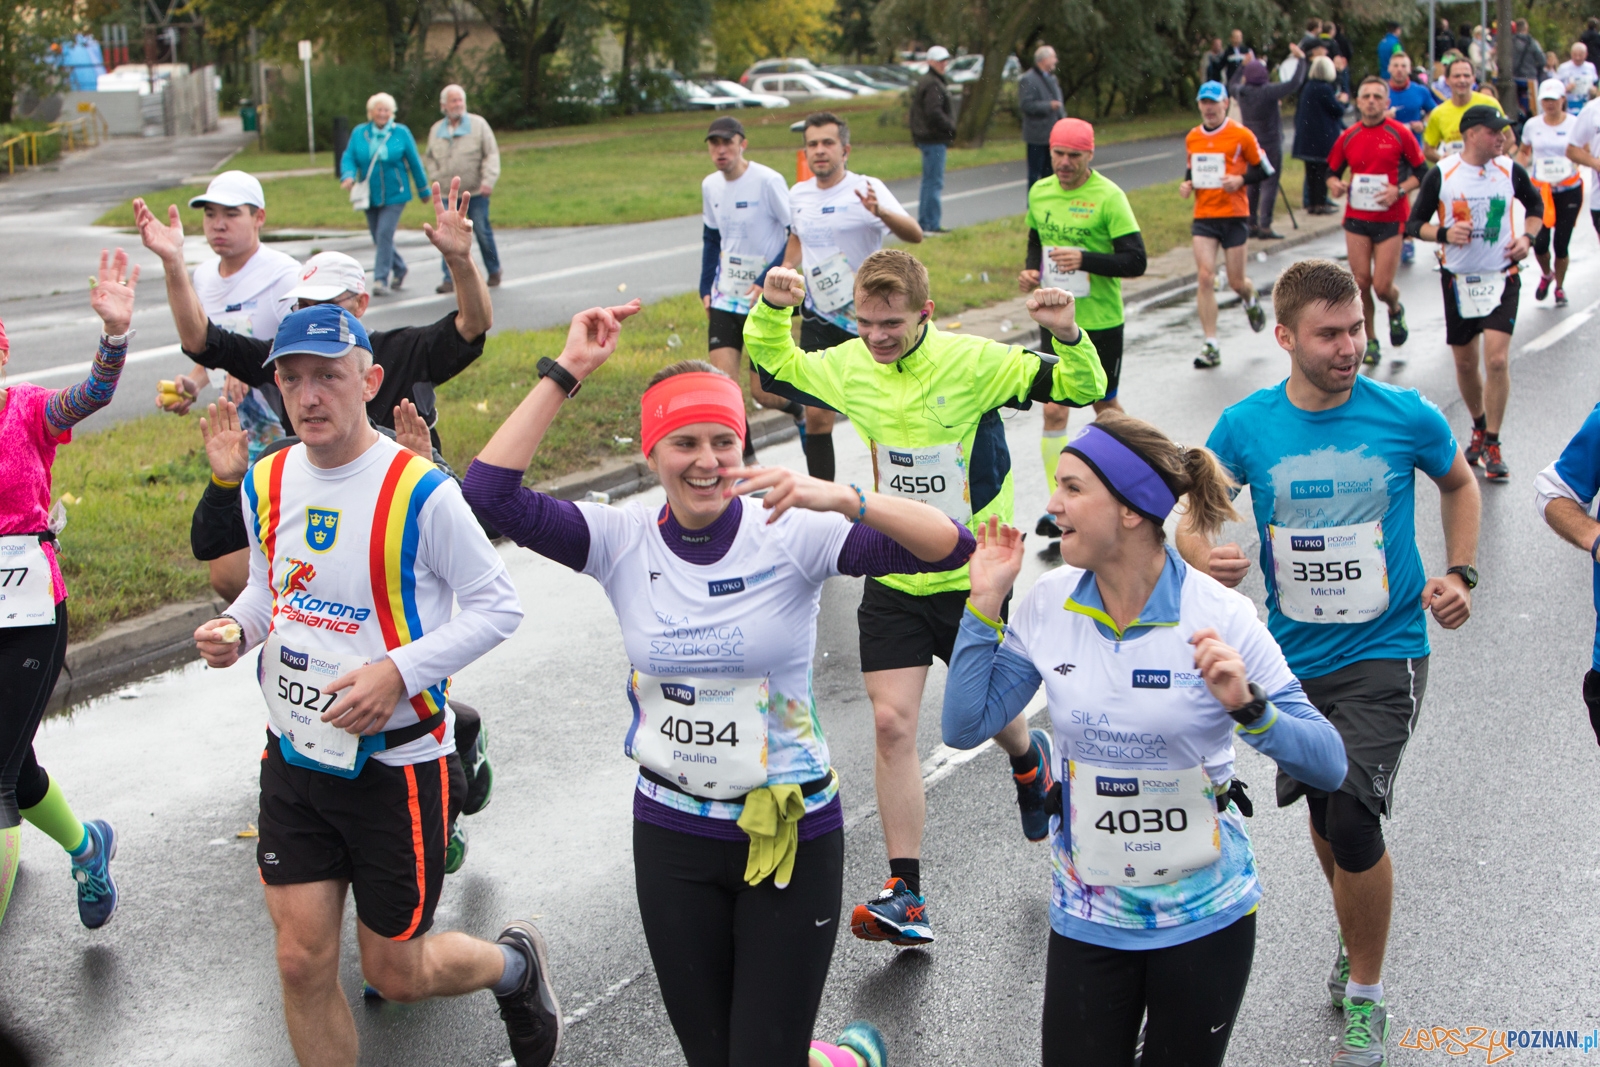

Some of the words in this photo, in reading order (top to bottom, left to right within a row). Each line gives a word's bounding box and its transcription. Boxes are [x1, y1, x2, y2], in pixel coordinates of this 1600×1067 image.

[728, 269, 756, 280] 3426
[1469, 285, 1495, 298] 1622
[890, 474, 946, 493] 4550
[1309, 485, 1330, 493] PKO
[1296, 507, 1326, 518] SIŁA
[1292, 559, 1362, 582] 3356
[1311, 587, 1346, 596] Michał
[290, 592, 371, 622] Korona
[281, 604, 360, 635] Pabianice
[663, 626, 744, 640] ODWAGA
[649, 640, 745, 657] SZYBKOŚĆ
[310, 664, 339, 677] maraton
[649, 663, 656, 672] 9
[658, 664, 718, 674] października
[721, 665, 745, 673] 2016
[1053, 663, 1077, 676] 4F
[278, 675, 338, 713] 5027
[699, 695, 735, 703] maraton
[291, 710, 312, 725] Piotr
[1071, 709, 1110, 727] SIŁA
[660, 715, 740, 747] 4034
[1083, 728, 1167, 746] ODWAGA
[1075, 740, 1168, 759] SZYBKOŚĆ
[673, 750, 717, 764] Paulina
[1095, 808, 1188, 835] 4030
[1124, 841, 1162, 852] Kasia
